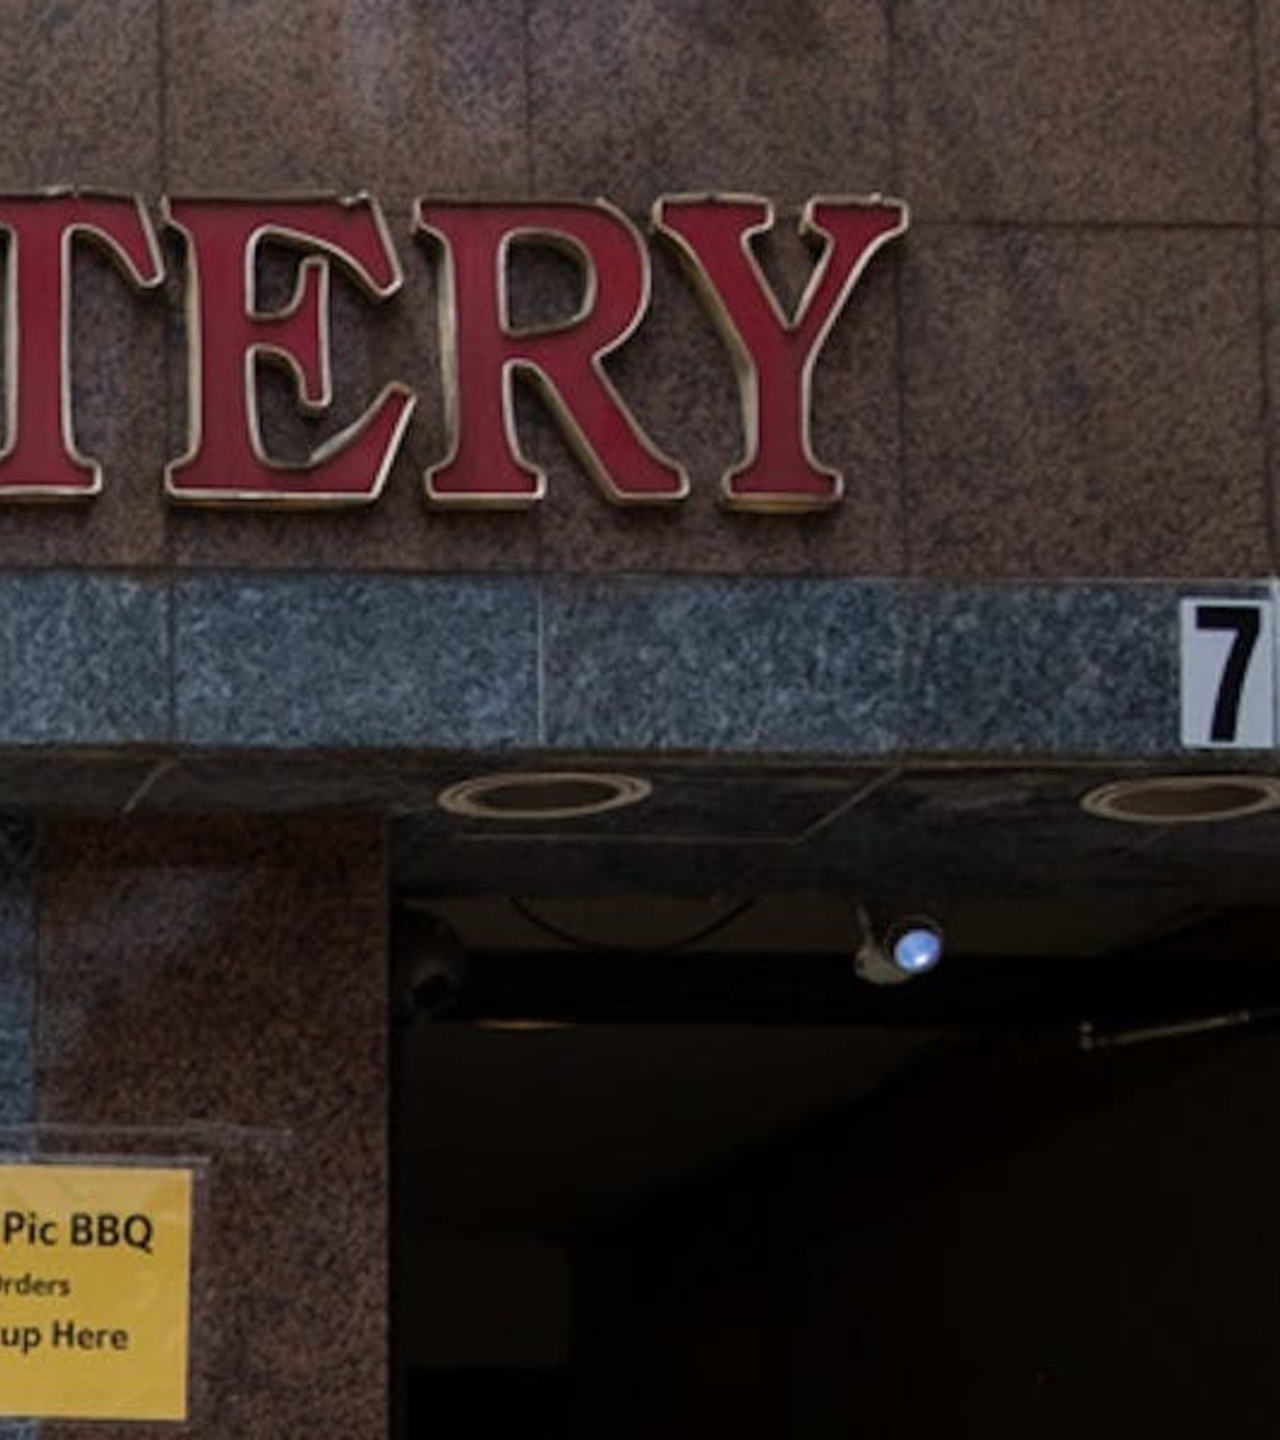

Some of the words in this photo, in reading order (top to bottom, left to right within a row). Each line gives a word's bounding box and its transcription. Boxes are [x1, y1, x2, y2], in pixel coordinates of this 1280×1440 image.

[1195, 605, 1261, 742] 7
[2, 1211, 58, 1246] Pic
[70, 1213, 155, 1253] BBQ
[52, 1321, 129, 1350] Here
